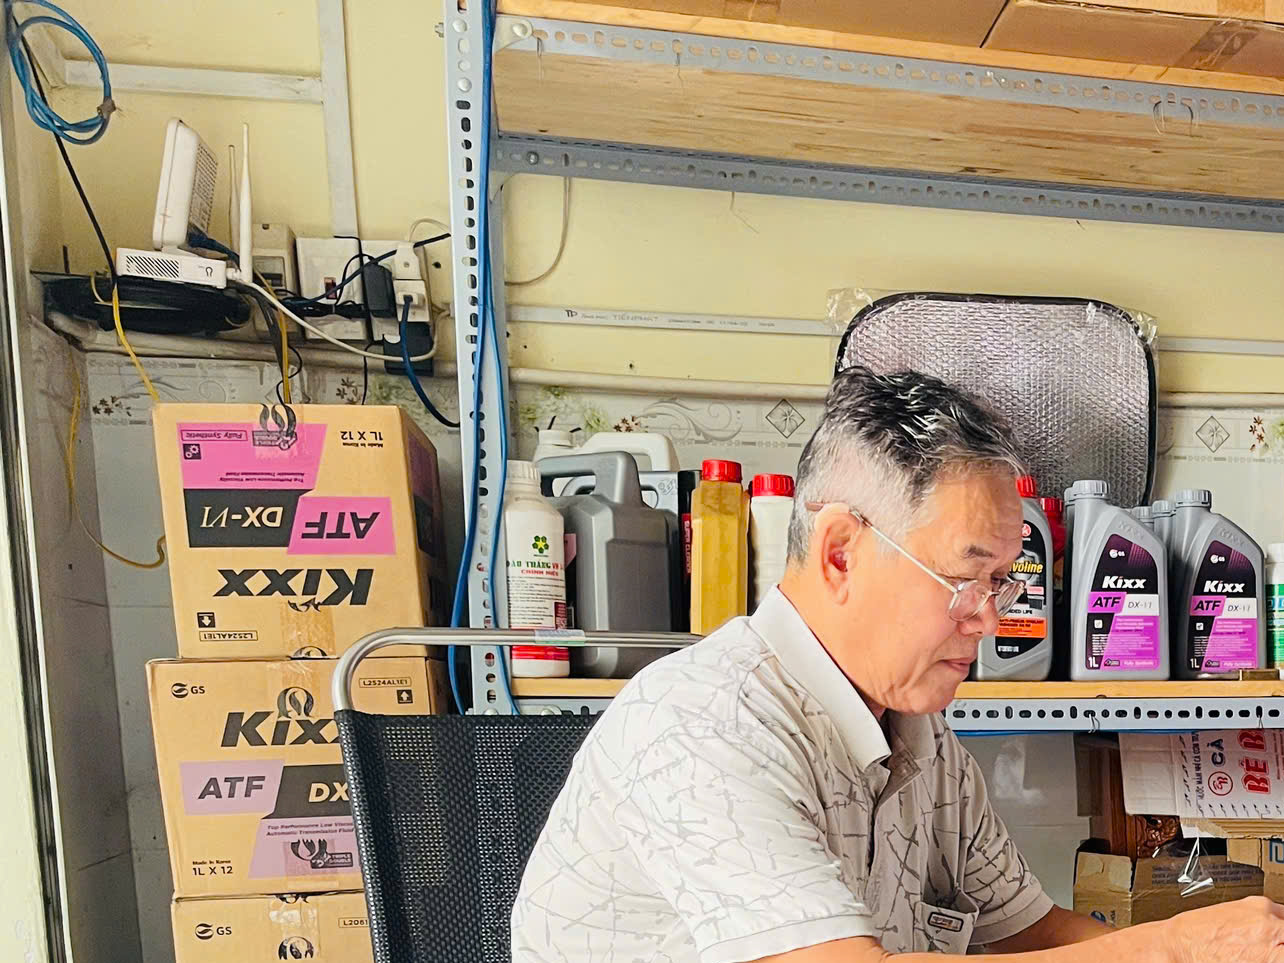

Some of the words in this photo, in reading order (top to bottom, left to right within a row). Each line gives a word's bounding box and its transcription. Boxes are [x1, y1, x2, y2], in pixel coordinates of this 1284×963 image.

[340, 431, 354, 441] 12
[300, 511, 380, 539] ATF
[1010, 561, 1044, 575] voline
[212, 568, 374, 606] Kixx
[1102, 575, 1146, 589] Kixx
[1203, 580, 1246, 593] Kixx
[1092, 596, 1122, 608] ATF
[1194, 599, 1222, 611] ATF
[1088, 656, 1099, 668] 1L
[1190, 658, 1200, 668] 1L
[190, 685, 206, 696] GS
[198, 775, 266, 800] ATF
[192, 866, 205, 876] 1L
[209, 866, 218, 875] X
[221, 865, 234, 875] 12
[216, 926, 232, 936] GS
